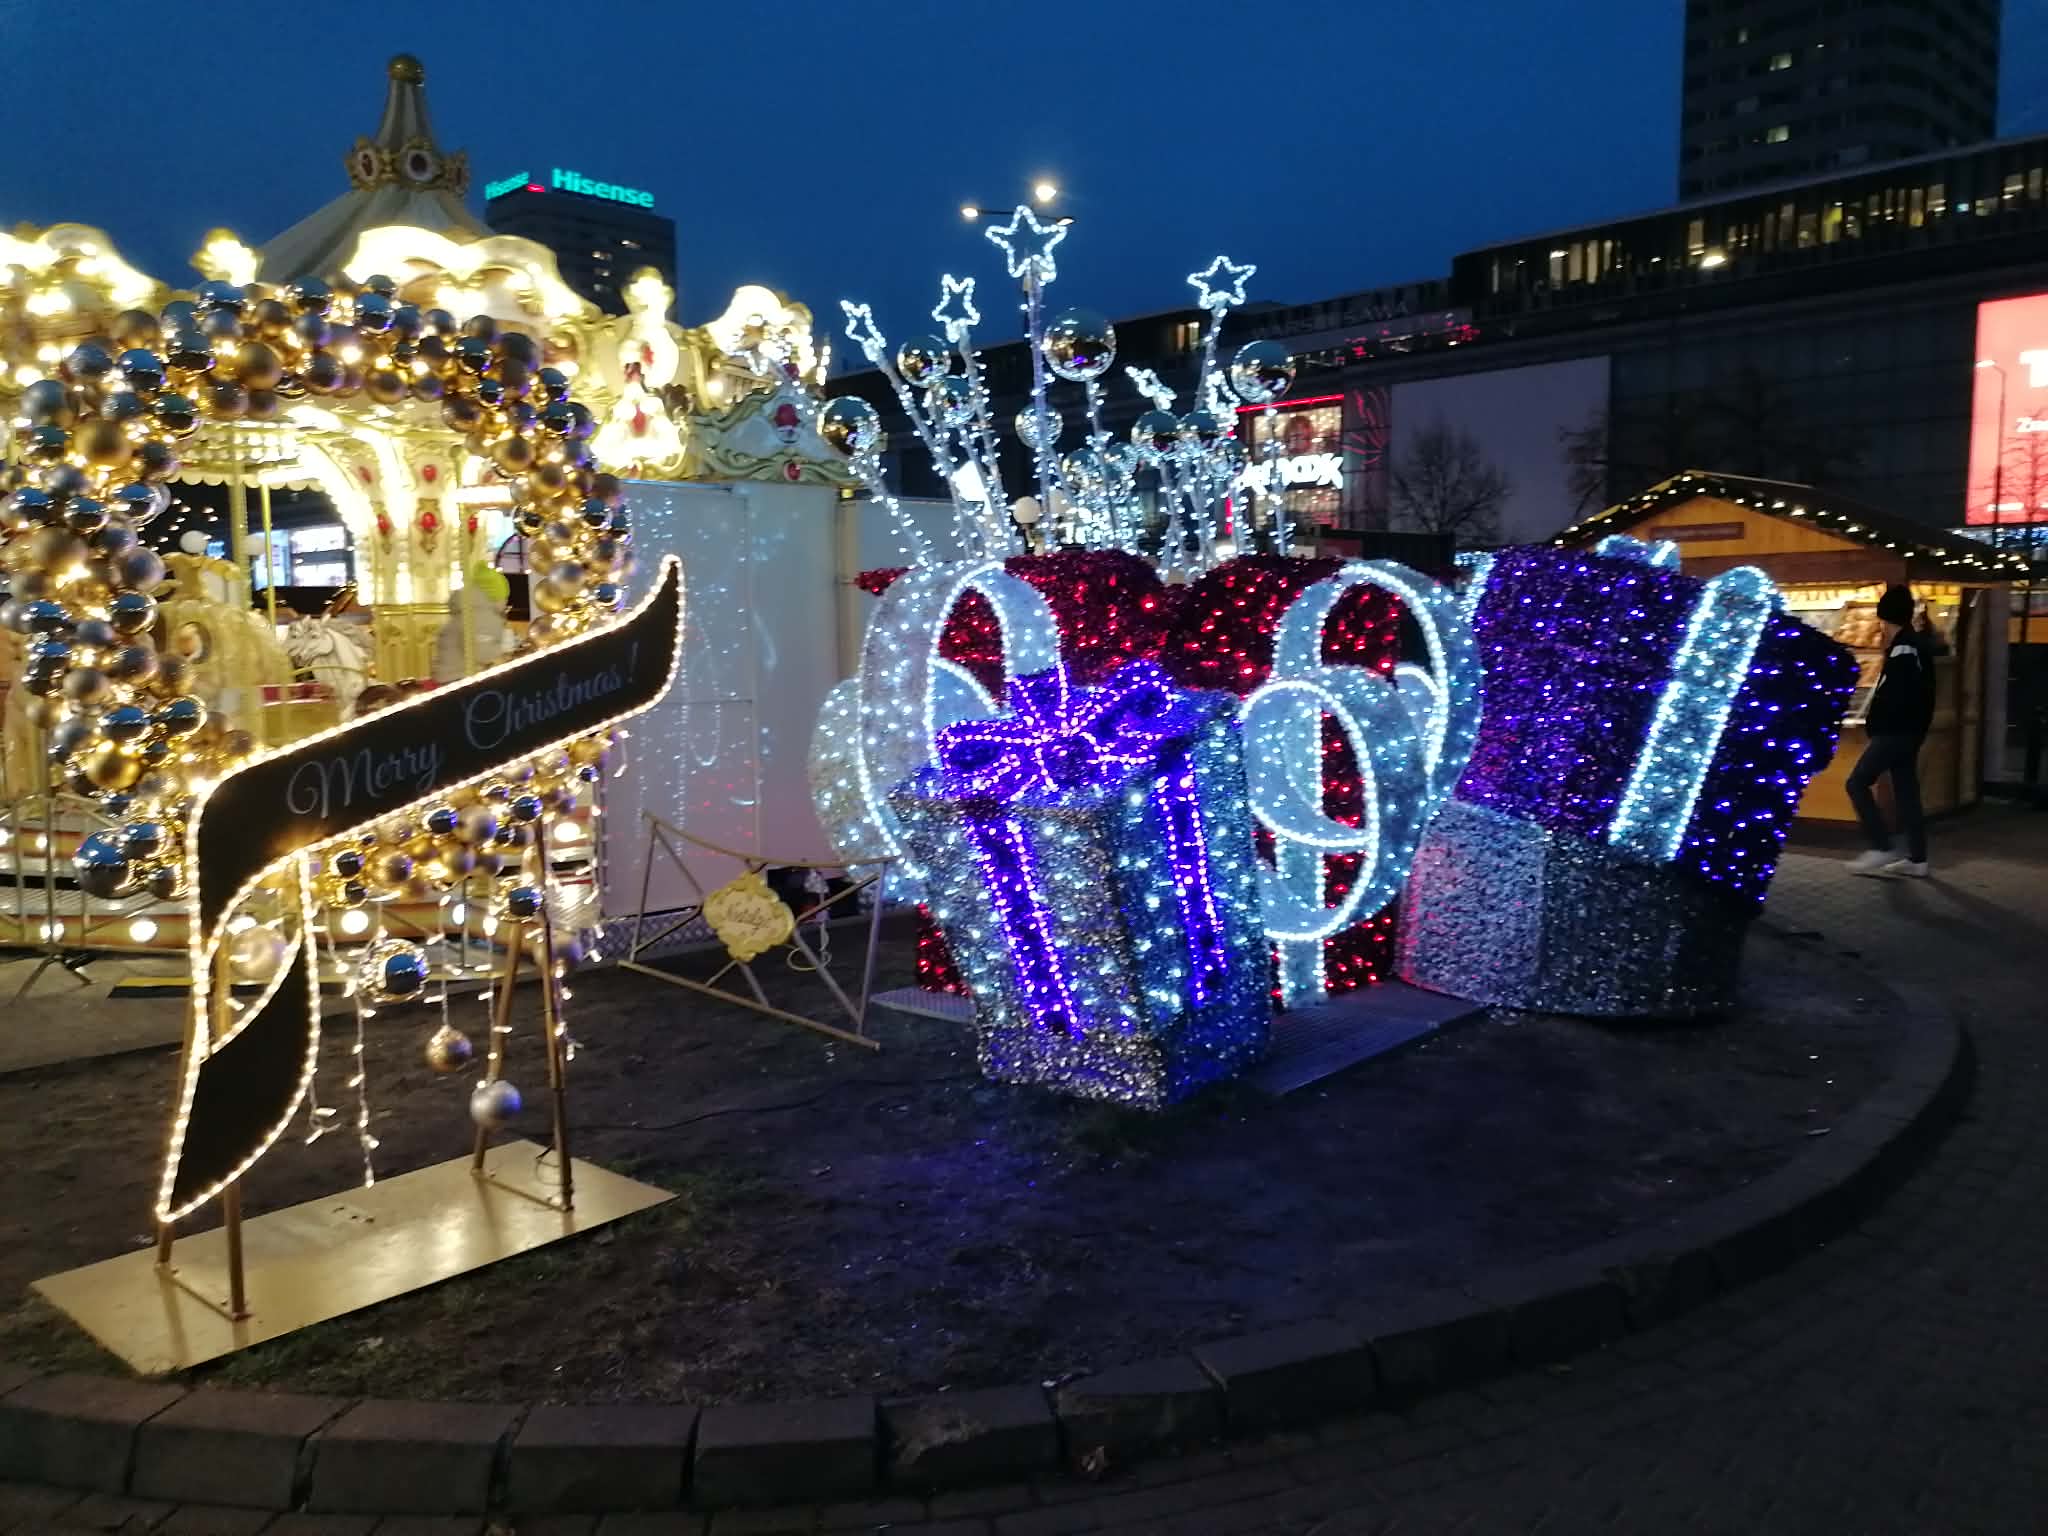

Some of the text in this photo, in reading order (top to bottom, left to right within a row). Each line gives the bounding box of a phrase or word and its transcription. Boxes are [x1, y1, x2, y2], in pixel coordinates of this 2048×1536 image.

[552, 168, 655, 207] Hisense
[285, 743, 441, 818] Merry
[464, 665, 623, 749] Christmas
